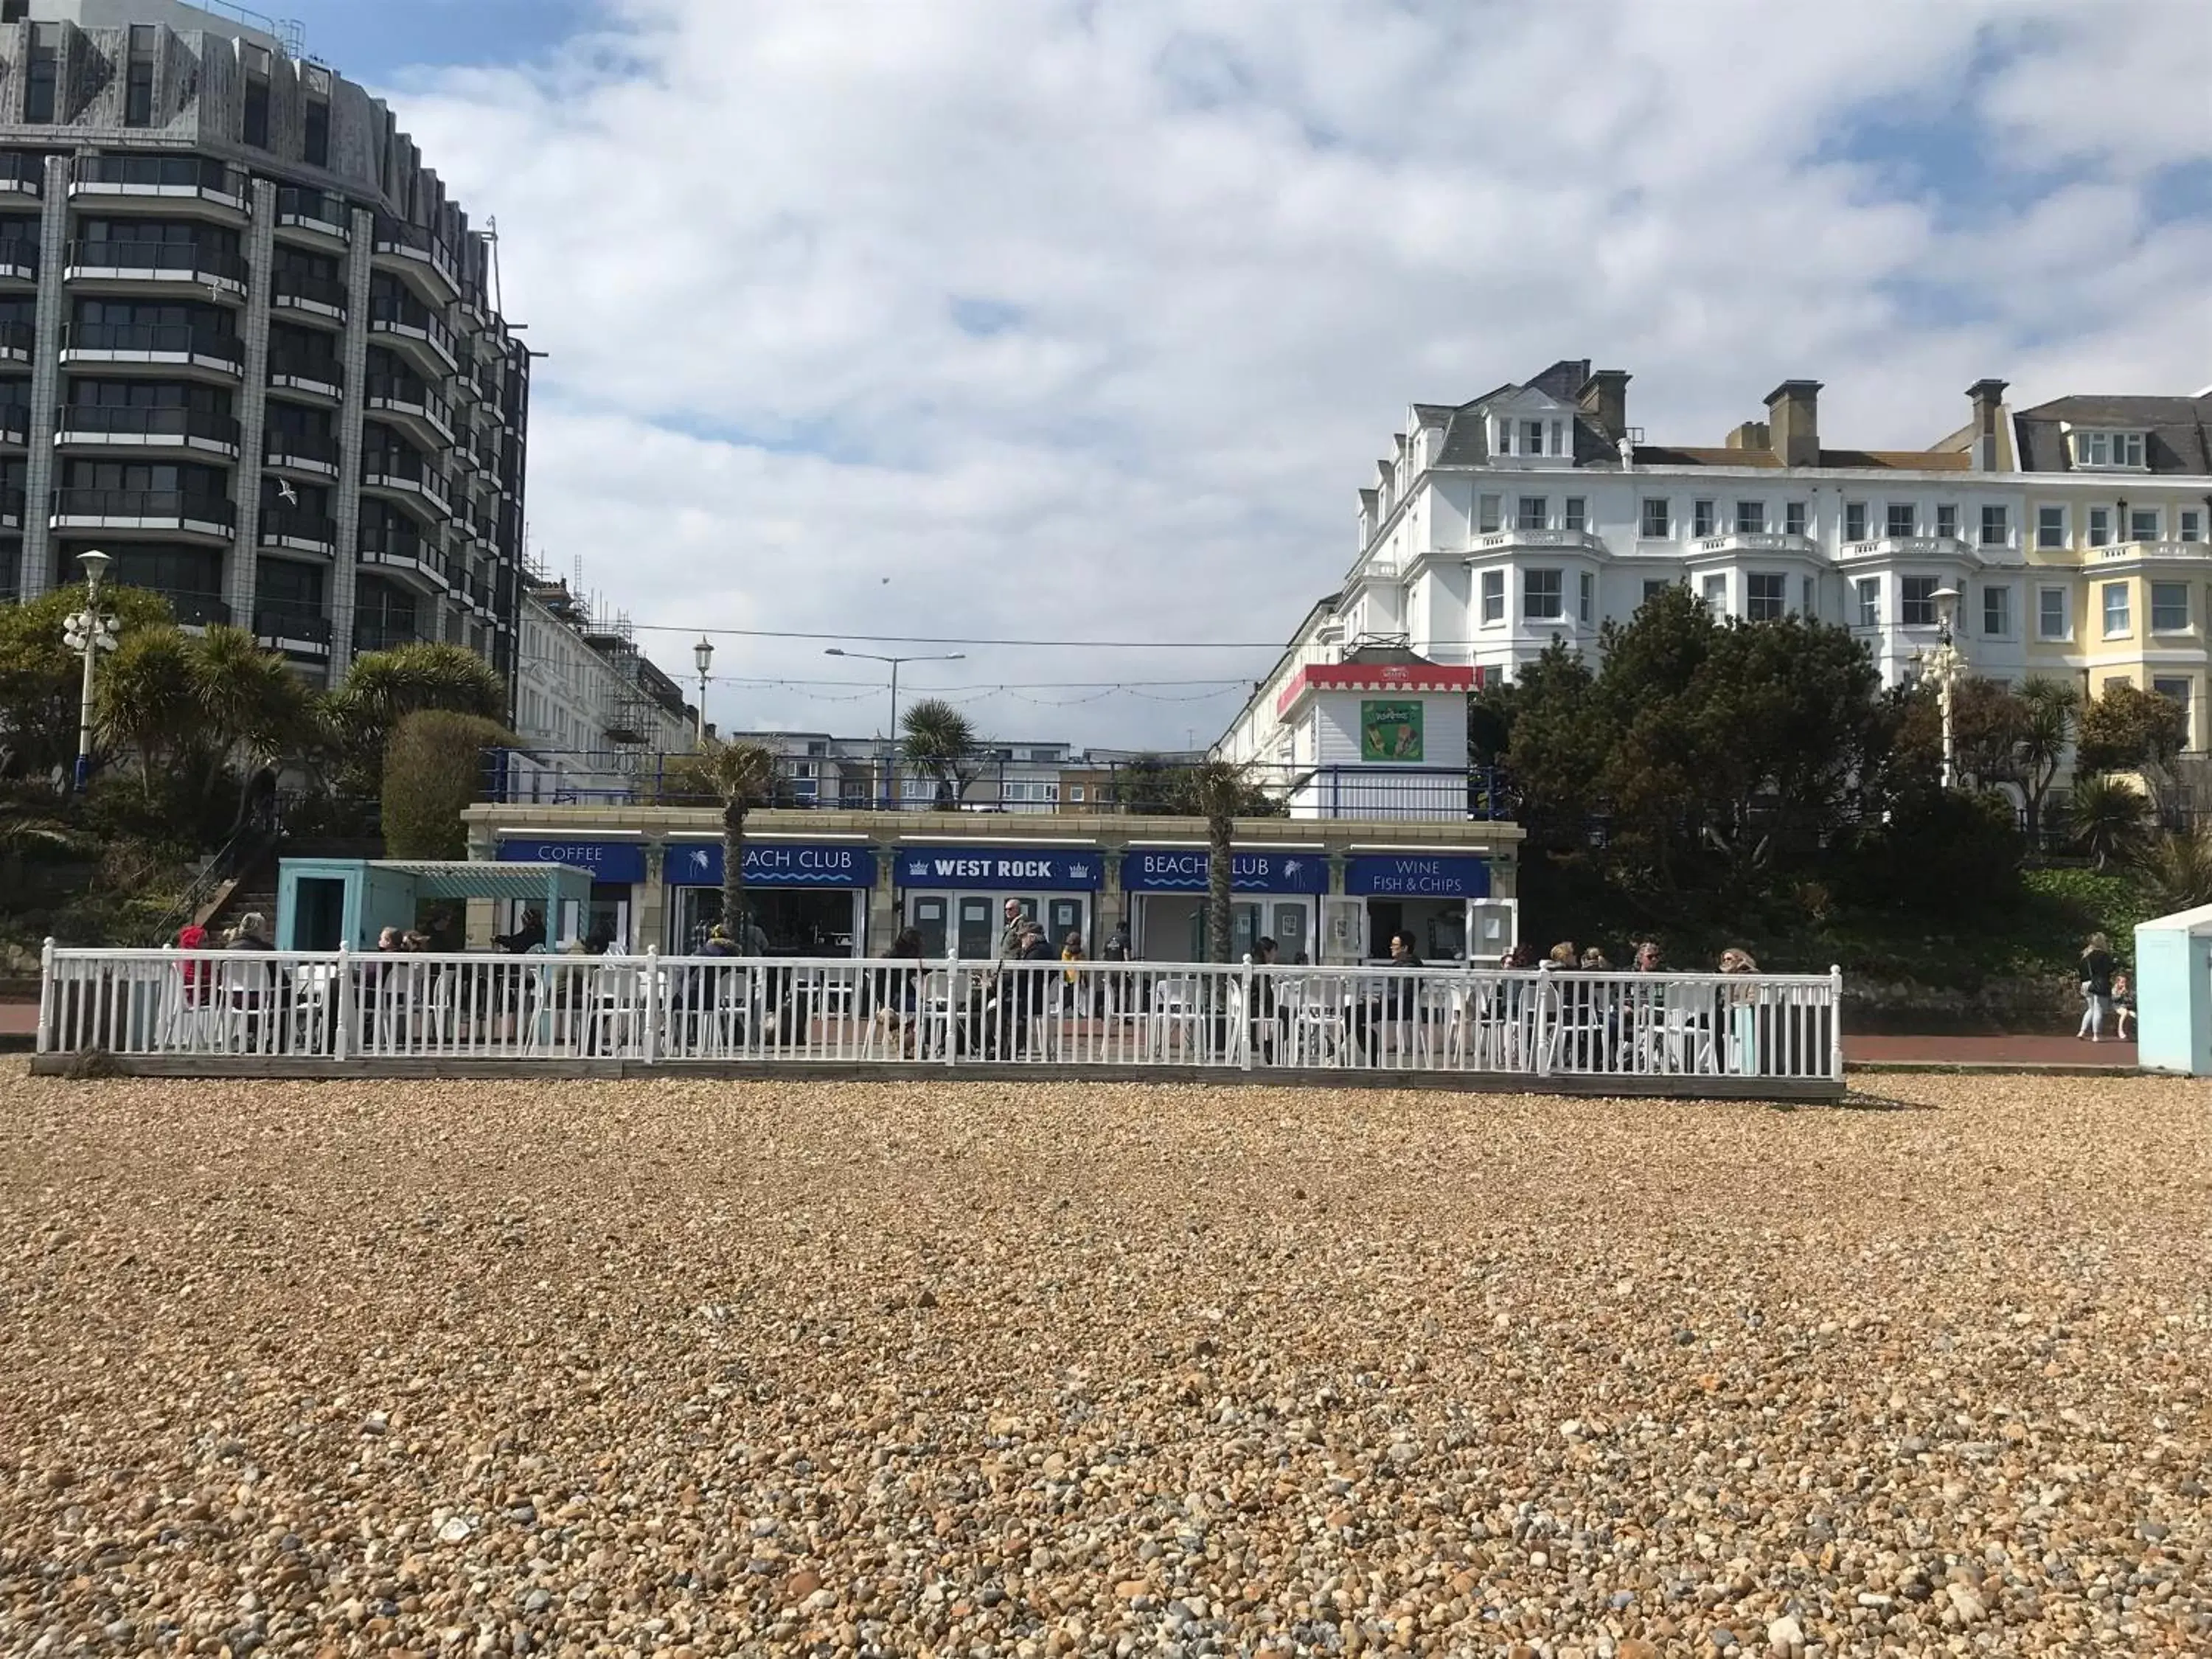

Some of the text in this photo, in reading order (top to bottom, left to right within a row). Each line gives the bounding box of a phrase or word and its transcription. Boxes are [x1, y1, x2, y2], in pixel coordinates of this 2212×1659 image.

[538, 846, 602, 860] COFFEE
[740, 850, 852, 868] ACH CLUB
[935, 859, 1051, 877] WEST ROCK
[1144, 856, 1269, 875] BEACH LUB
[1396, 860, 1439, 874] WINE
[1374, 875, 1462, 891] FISH & CHIPS
